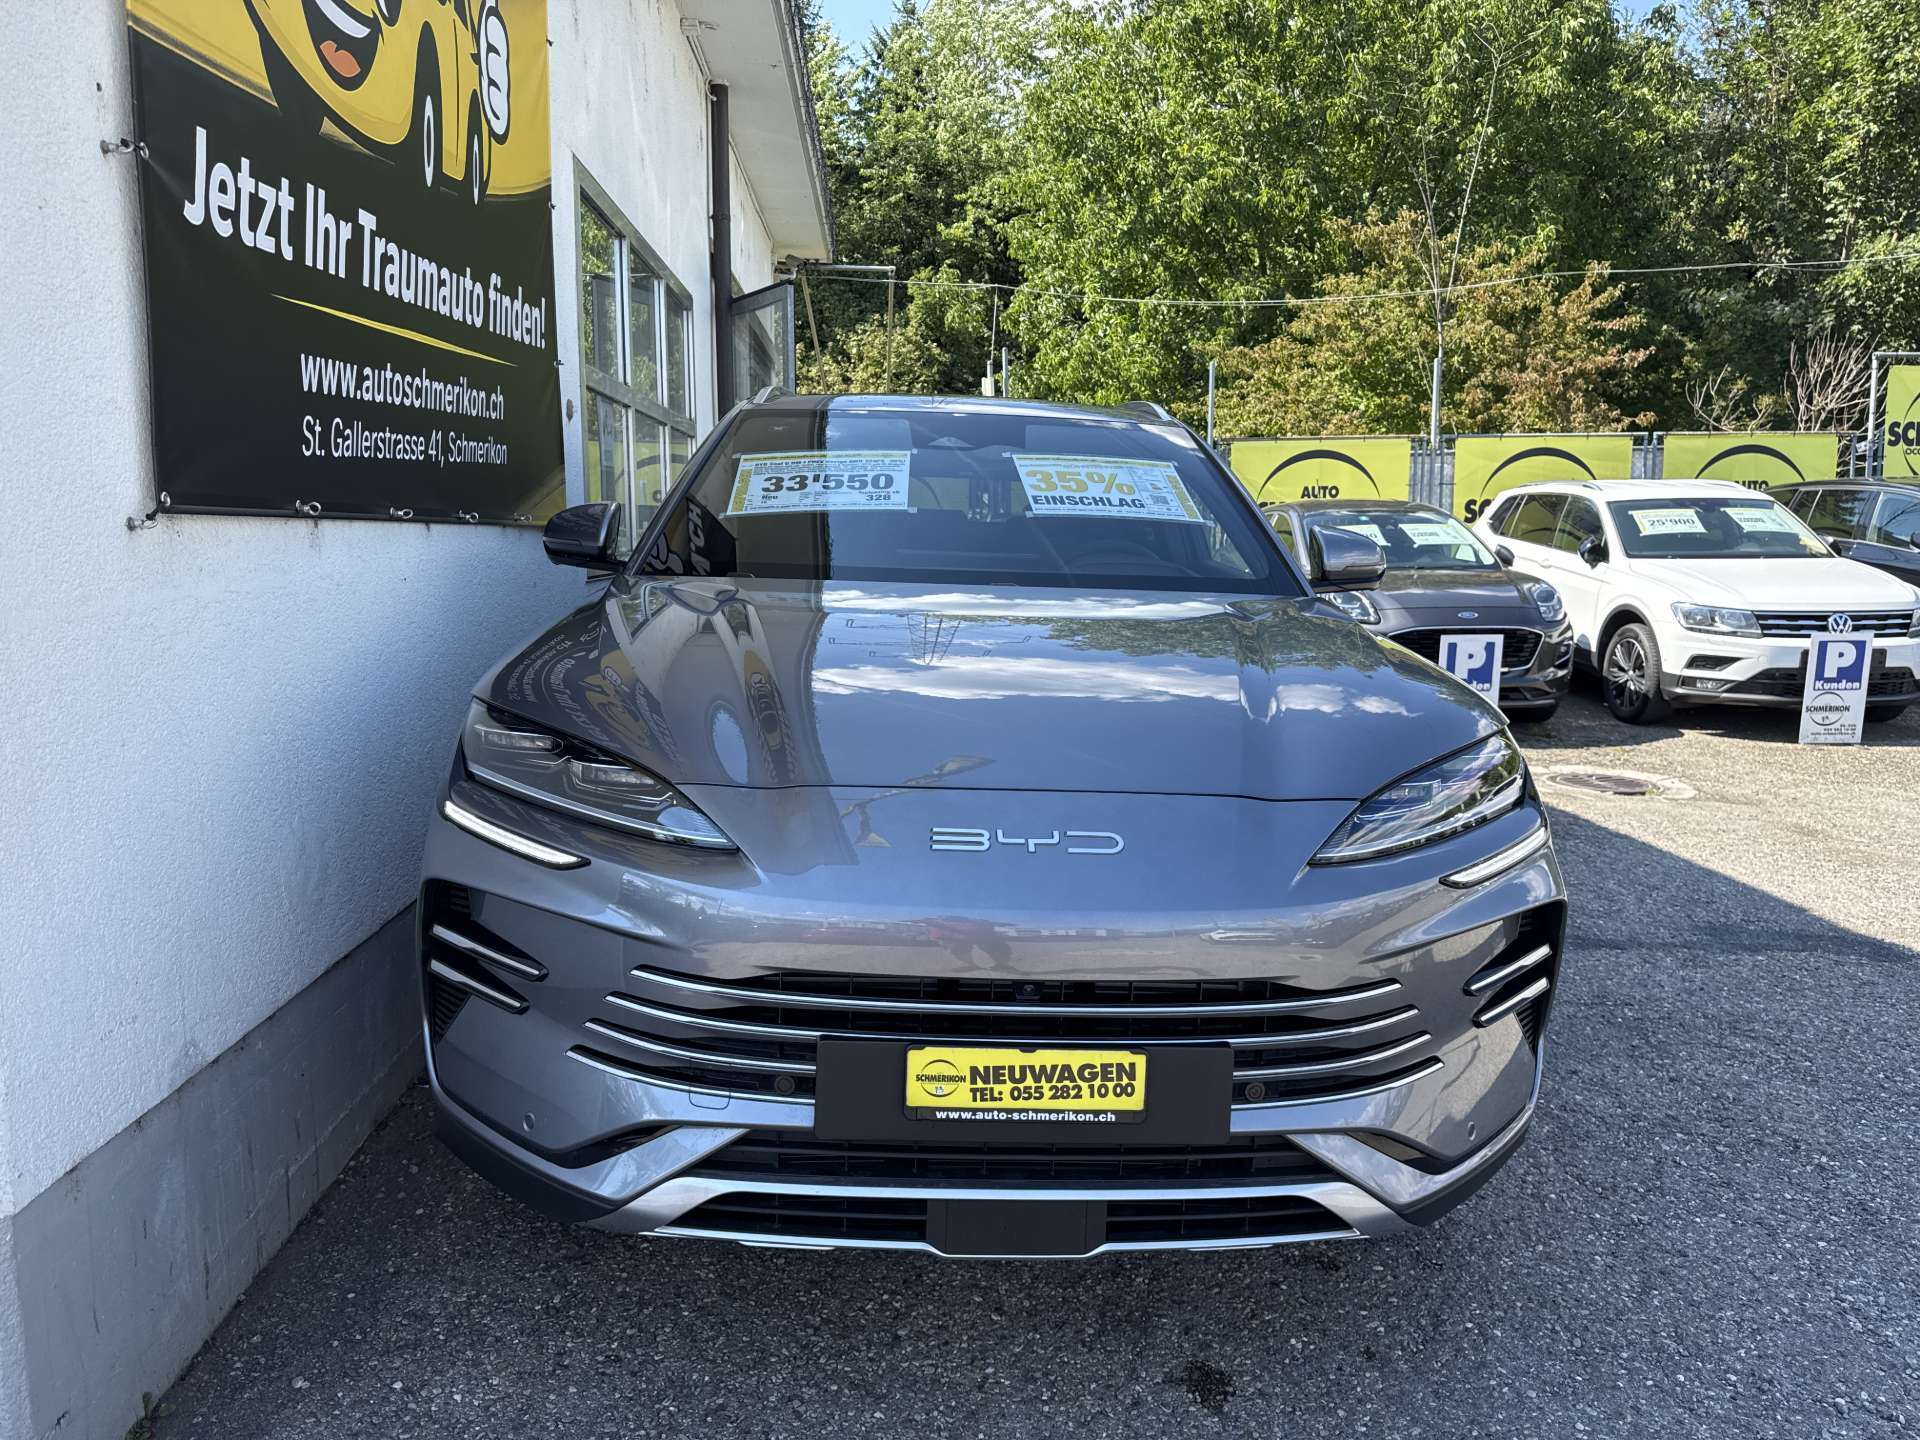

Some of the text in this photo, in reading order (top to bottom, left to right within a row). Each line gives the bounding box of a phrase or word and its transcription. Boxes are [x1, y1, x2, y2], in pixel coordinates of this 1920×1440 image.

[183, 126, 547, 349] Jetzt Ihr Traumauto finden!
[301, 353, 504, 421] www.autoschmerikon.ch
[302, 415, 508, 470] St. Gallerstrasse 41, Schmerikon
[761, 473, 894, 493] 33'550
[1024, 469, 1136, 496] 35%
[1301, 485, 1340, 499] AUTO
[1032, 494, 1146, 509] EINSCHLAG
[1823, 641, 1857, 678] P
[1814, 680, 1860, 690] Kunden
[1805, 704, 1851, 713] SCHMERIKON
[929, 826, 1125, 855] BYD
[915, 1073, 966, 1084] SCHMERIKON
[969, 1062, 1137, 1086] NEUWAGEN
[970, 1081, 1136, 1103] TEL: 055 282 10 00
[935, 1109, 1116, 1122] www.auto-schmerikon.ch
